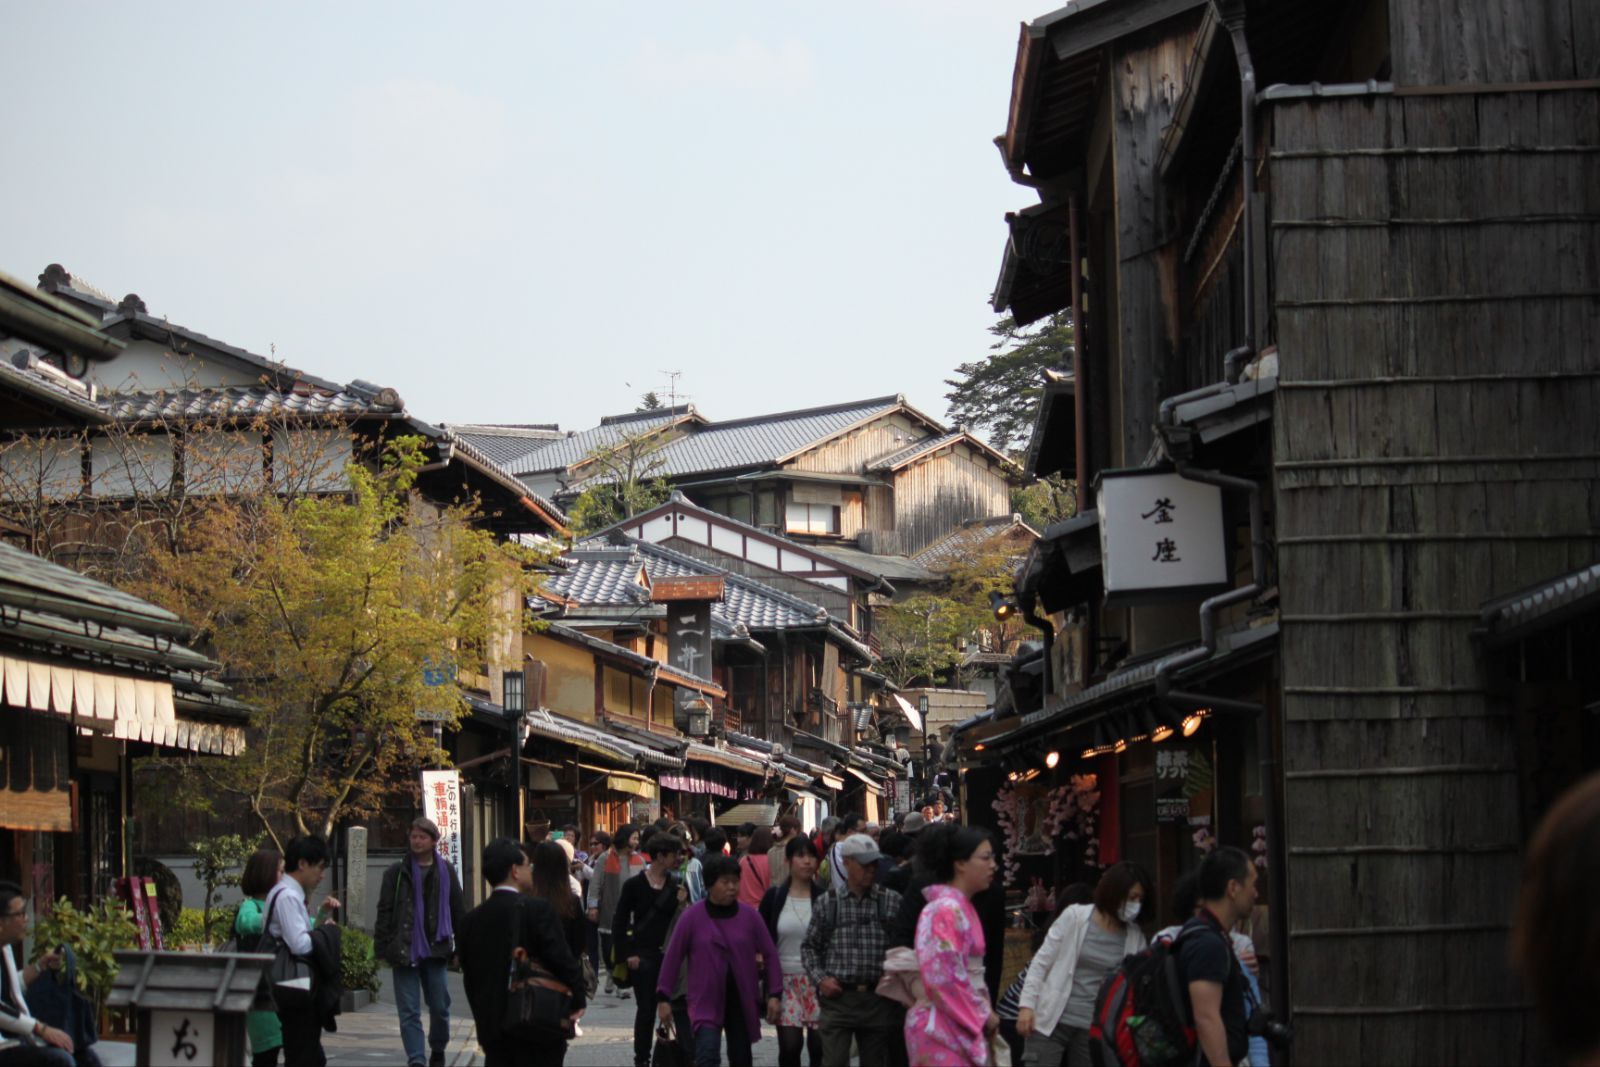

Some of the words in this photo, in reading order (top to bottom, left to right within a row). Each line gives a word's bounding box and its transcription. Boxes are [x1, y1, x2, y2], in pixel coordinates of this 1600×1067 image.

[1141, 497, 1181, 563] 釜座
[1156, 767, 1189, 779] ソフト
